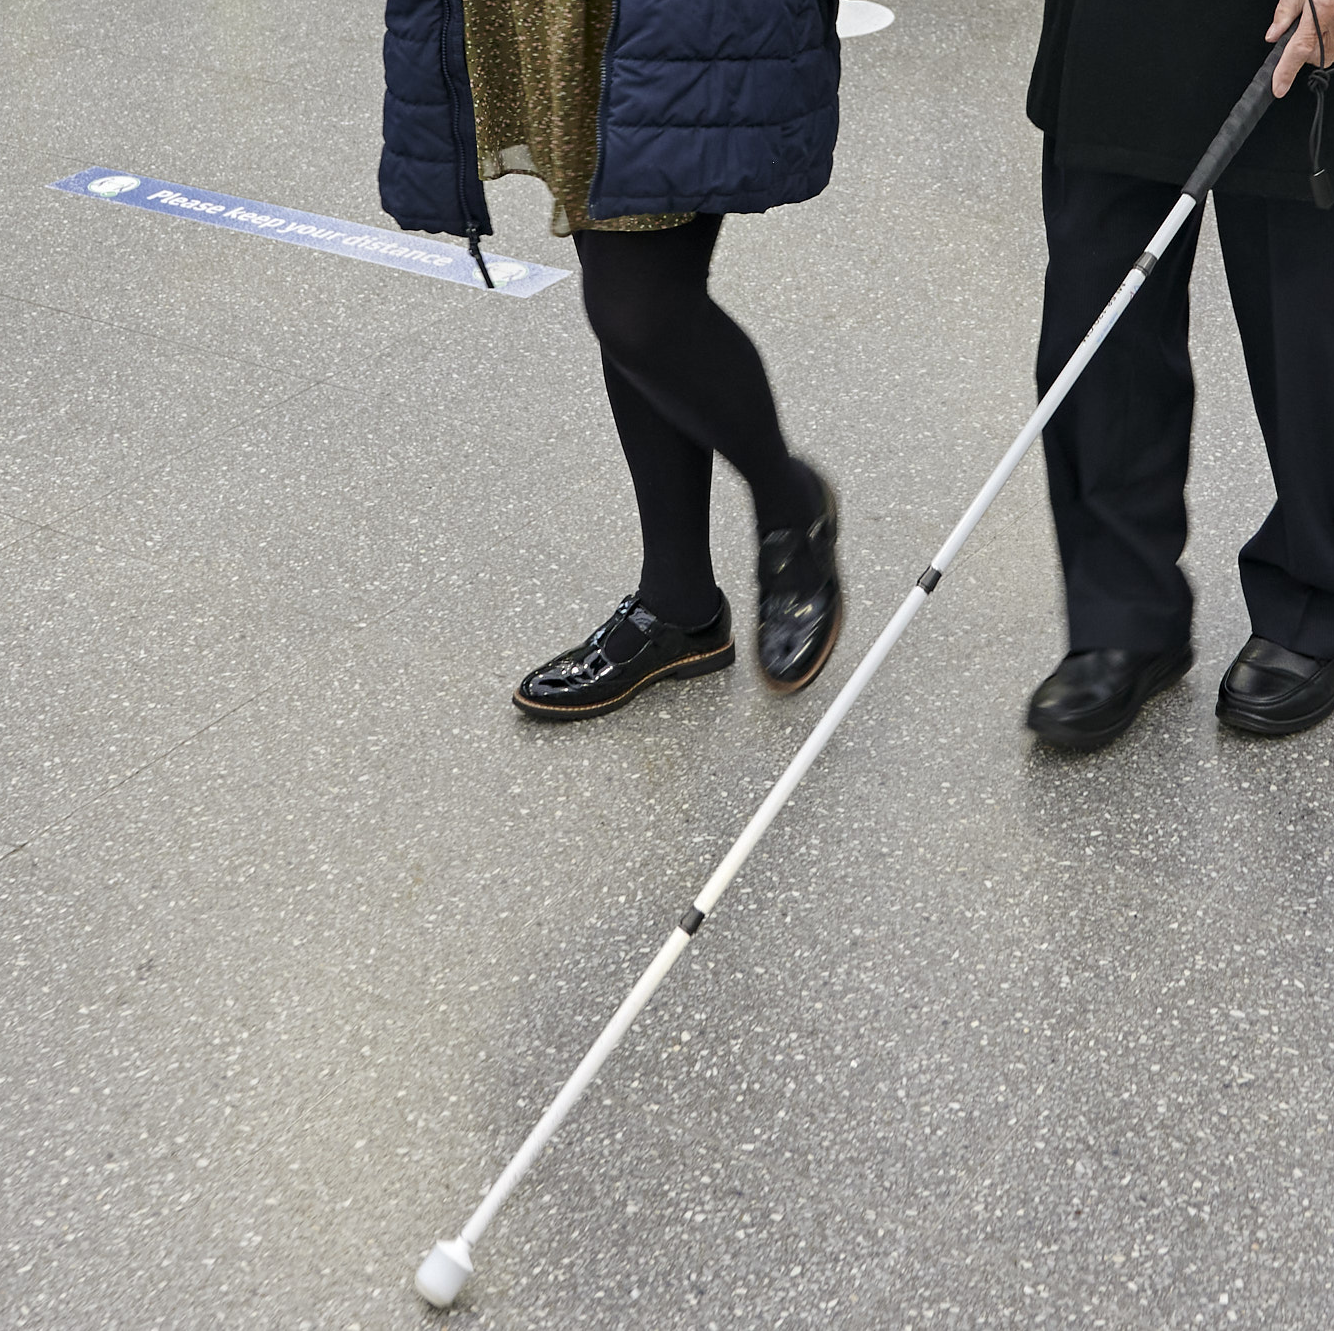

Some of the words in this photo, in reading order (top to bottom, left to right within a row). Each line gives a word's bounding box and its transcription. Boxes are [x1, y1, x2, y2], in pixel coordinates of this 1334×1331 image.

[147, 189, 226, 215] Please
[223, 206, 286, 229] keep
[276, 220, 344, 242] your
[342, 234, 453, 267] distance
